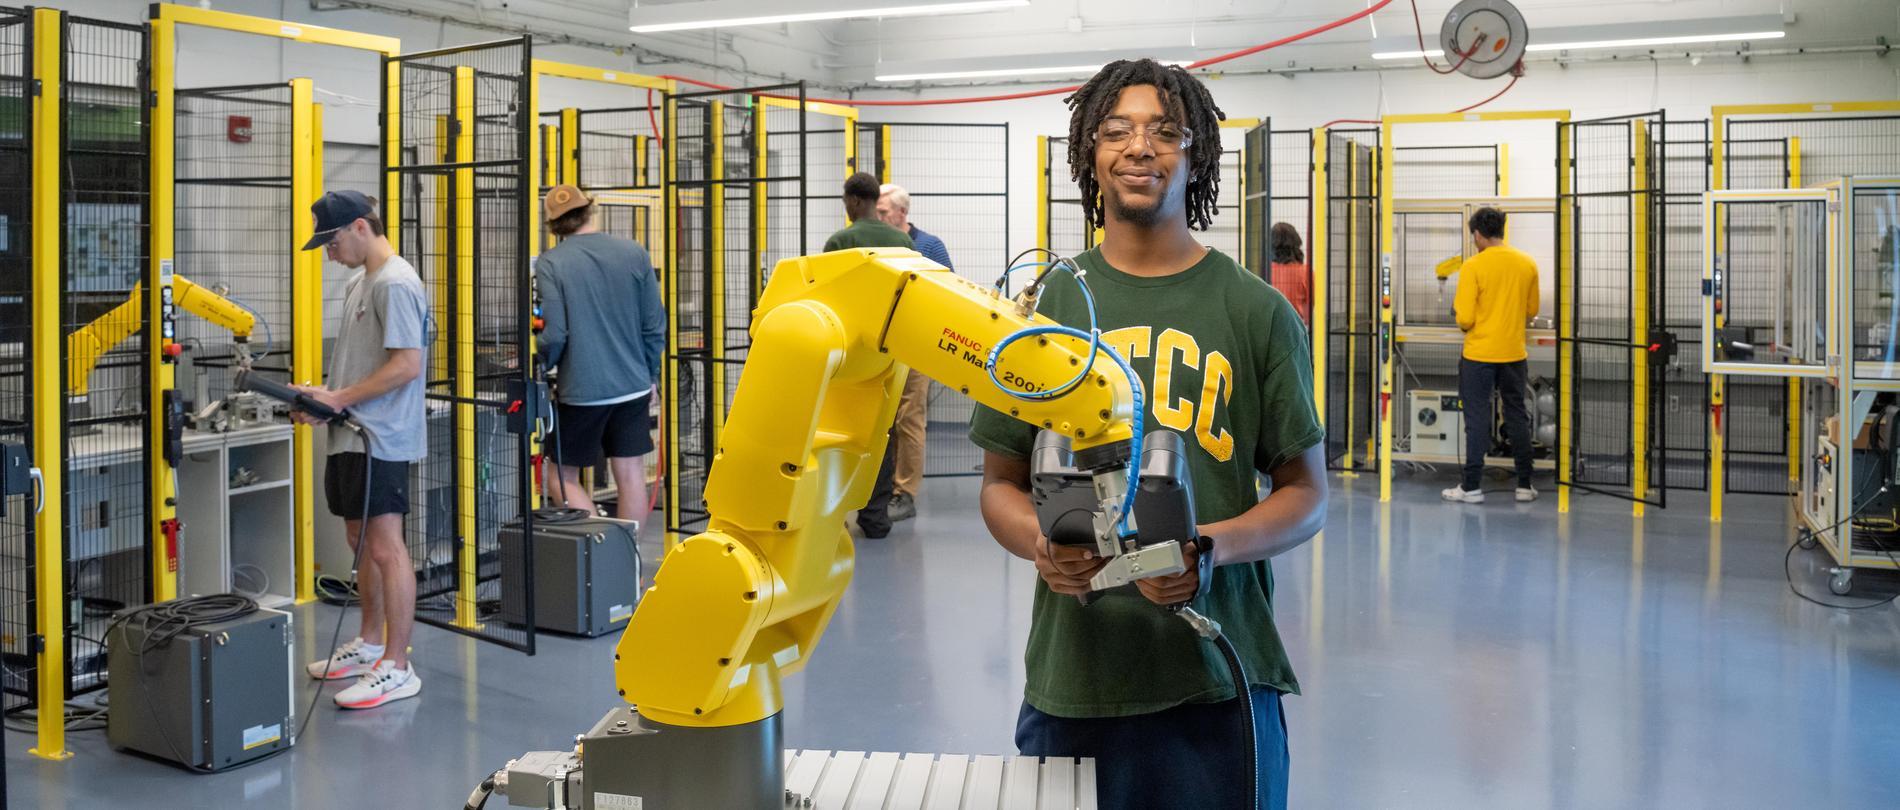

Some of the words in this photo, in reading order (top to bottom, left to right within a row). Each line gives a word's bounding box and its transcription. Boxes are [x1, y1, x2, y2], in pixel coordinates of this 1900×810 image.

[943, 328, 981, 351] FANUC
[938, 338, 958, 355] LR
[962, 352, 997, 372] Mat
